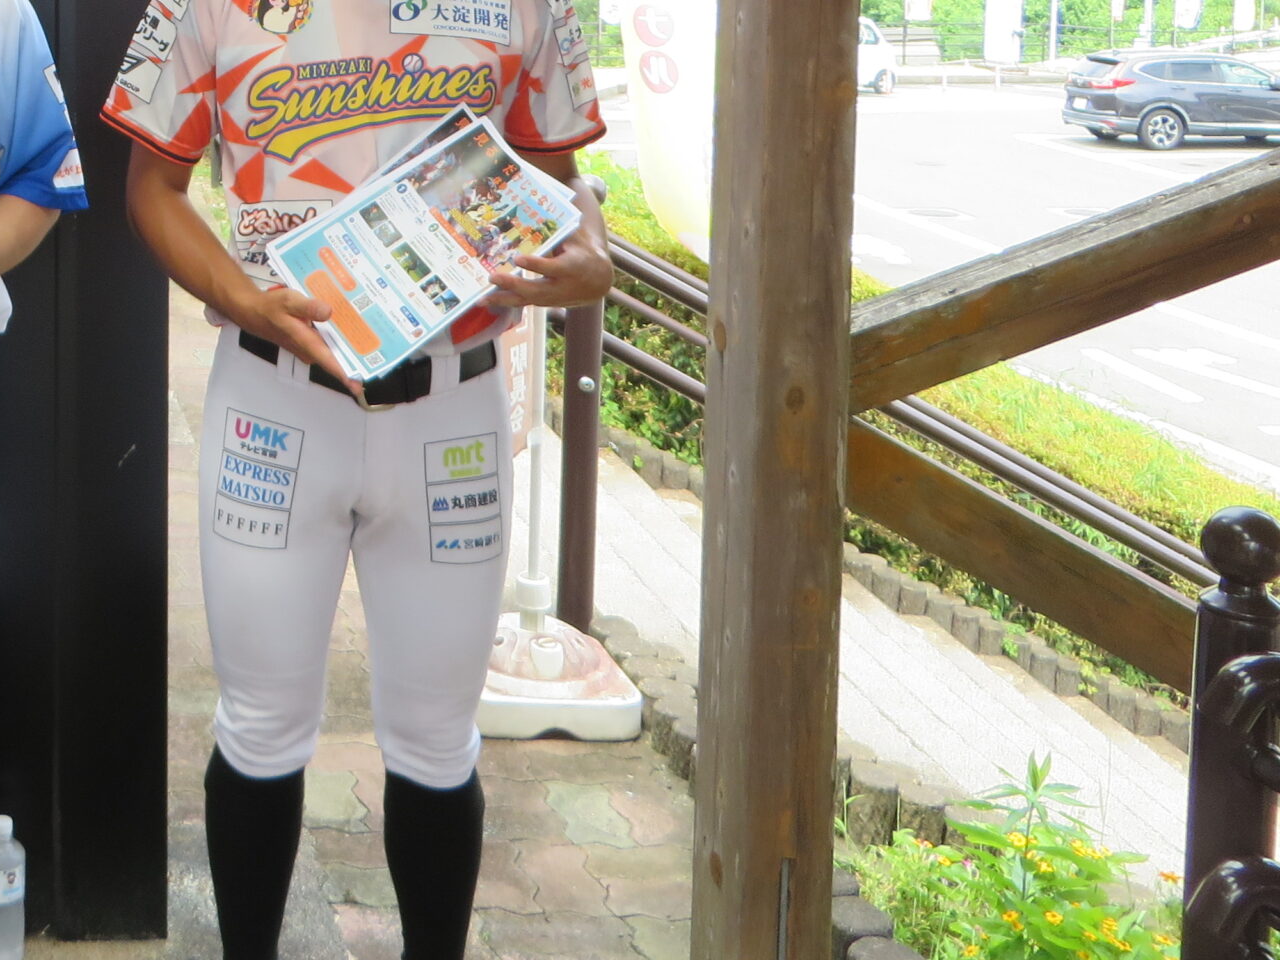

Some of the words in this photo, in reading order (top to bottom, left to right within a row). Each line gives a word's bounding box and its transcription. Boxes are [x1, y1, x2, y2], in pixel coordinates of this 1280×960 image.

[431, 3, 508, 31] 大淀開発
[298, 59, 372, 80] MIYAZAKI
[246, 56, 493, 139] Sunshines
[234, 417, 290, 451] UMK
[239, 441, 278, 460] テレビ宮崎
[443, 439, 485, 468] mrt
[223, 455, 291, 487] EXPRESS
[220, 474, 285, 506] MATSUO
[450, 488, 498, 510] 丸商建設
